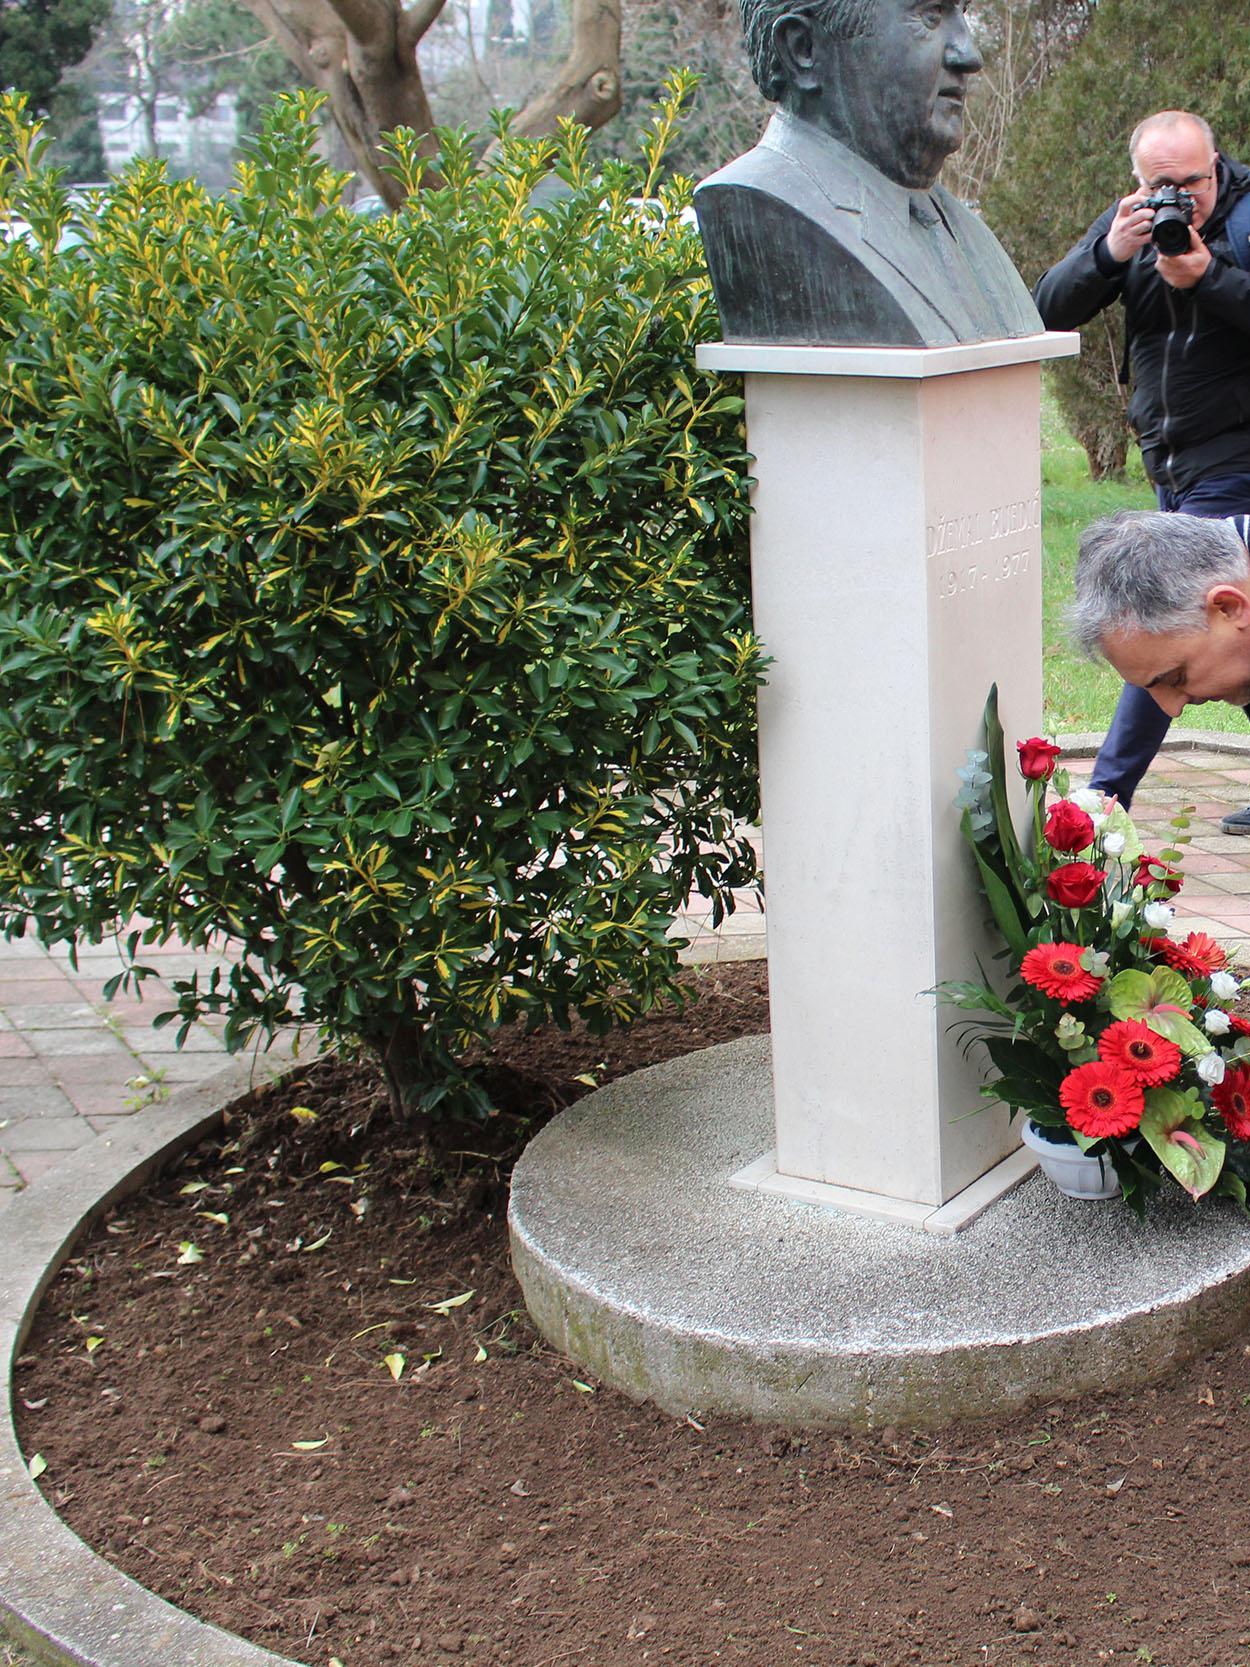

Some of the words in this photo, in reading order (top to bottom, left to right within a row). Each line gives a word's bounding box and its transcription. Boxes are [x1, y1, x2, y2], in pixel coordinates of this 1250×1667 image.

[926, 513, 983, 559] DŽEMAL
[989, 488, 1040, 540] BIJEDIĆ
[939, 565, 977, 598] 1917
[994, 549, 1030, 581] 1977
